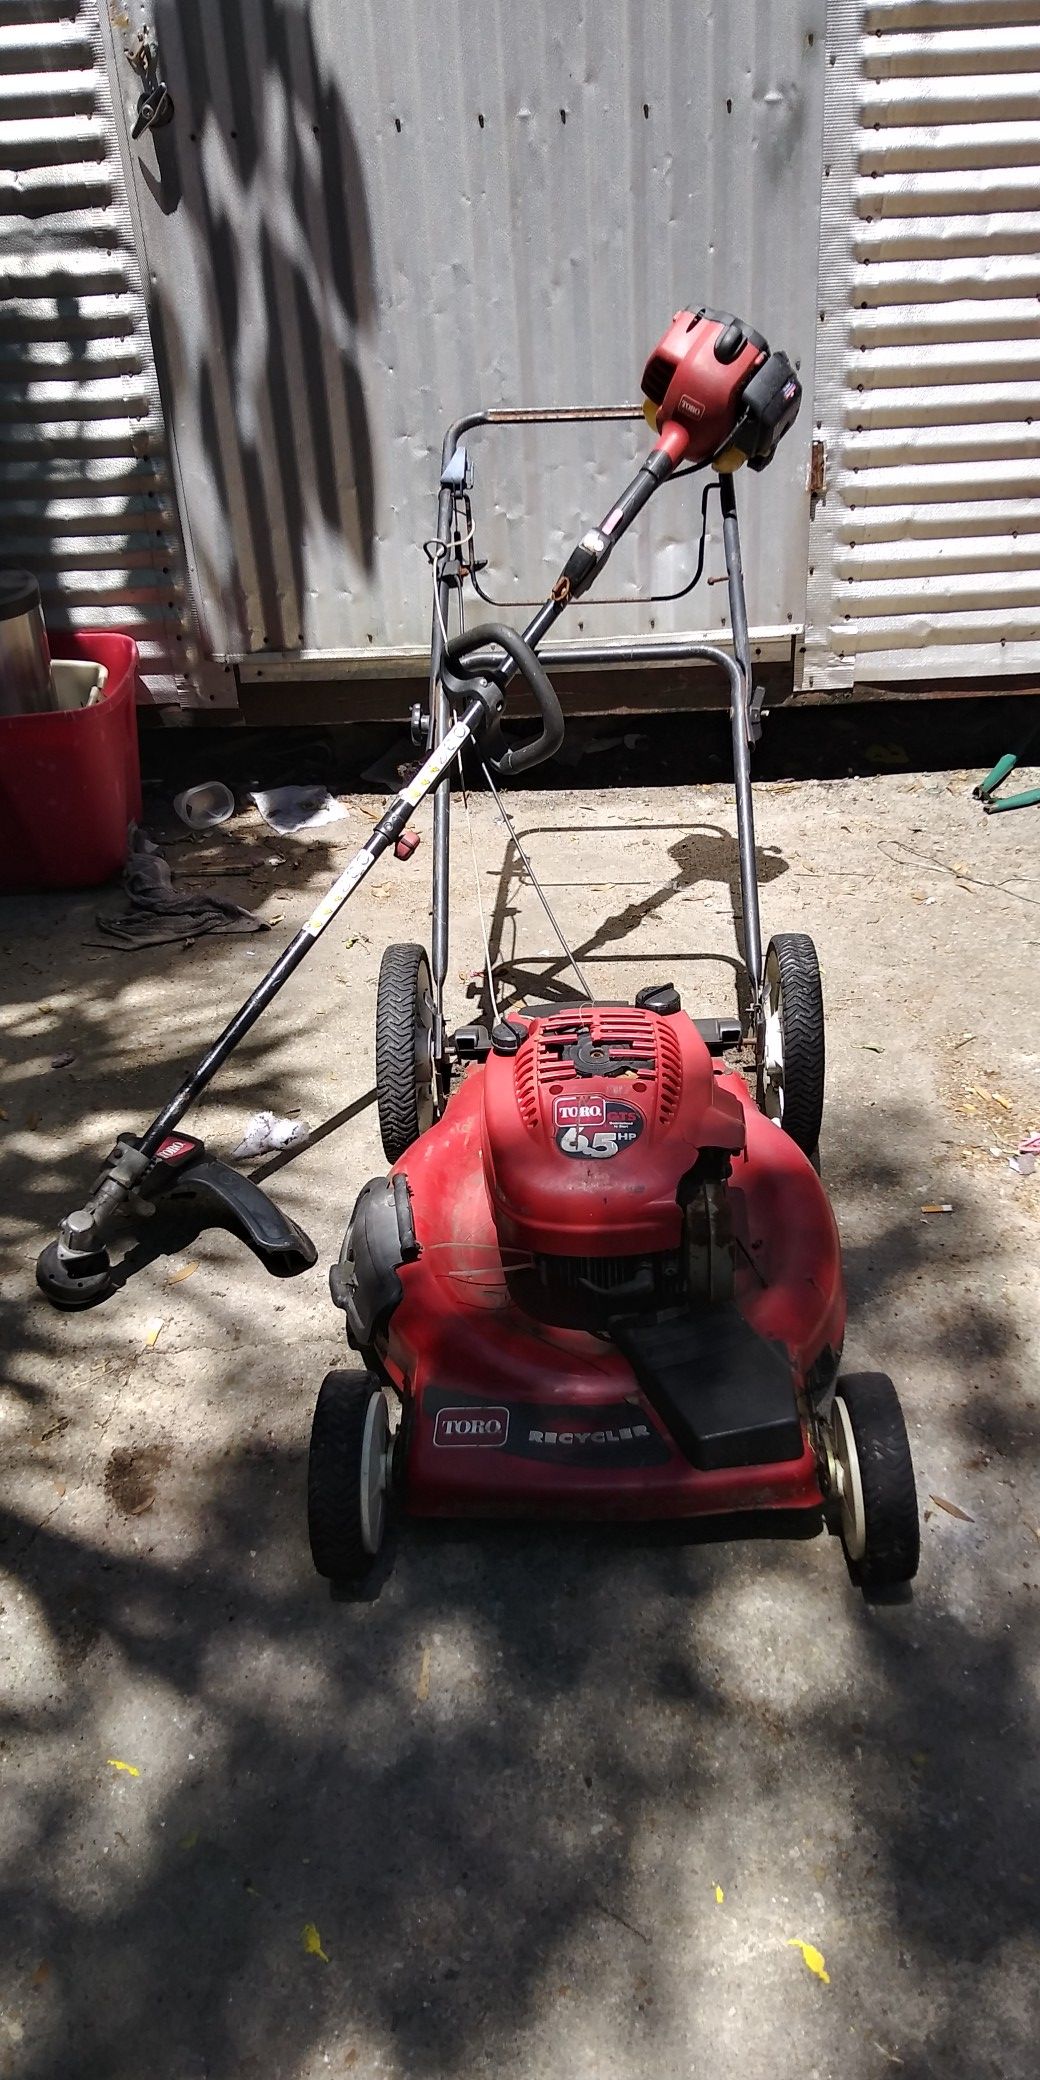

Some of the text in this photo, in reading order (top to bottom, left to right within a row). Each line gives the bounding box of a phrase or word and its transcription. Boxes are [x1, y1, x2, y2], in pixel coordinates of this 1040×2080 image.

[682, 400, 700, 415] TORO
[559, 1106, 601, 1118] TORO
[442, 1419, 501, 1434] TORO
[529, 1424, 650, 1445] RECYCLER
